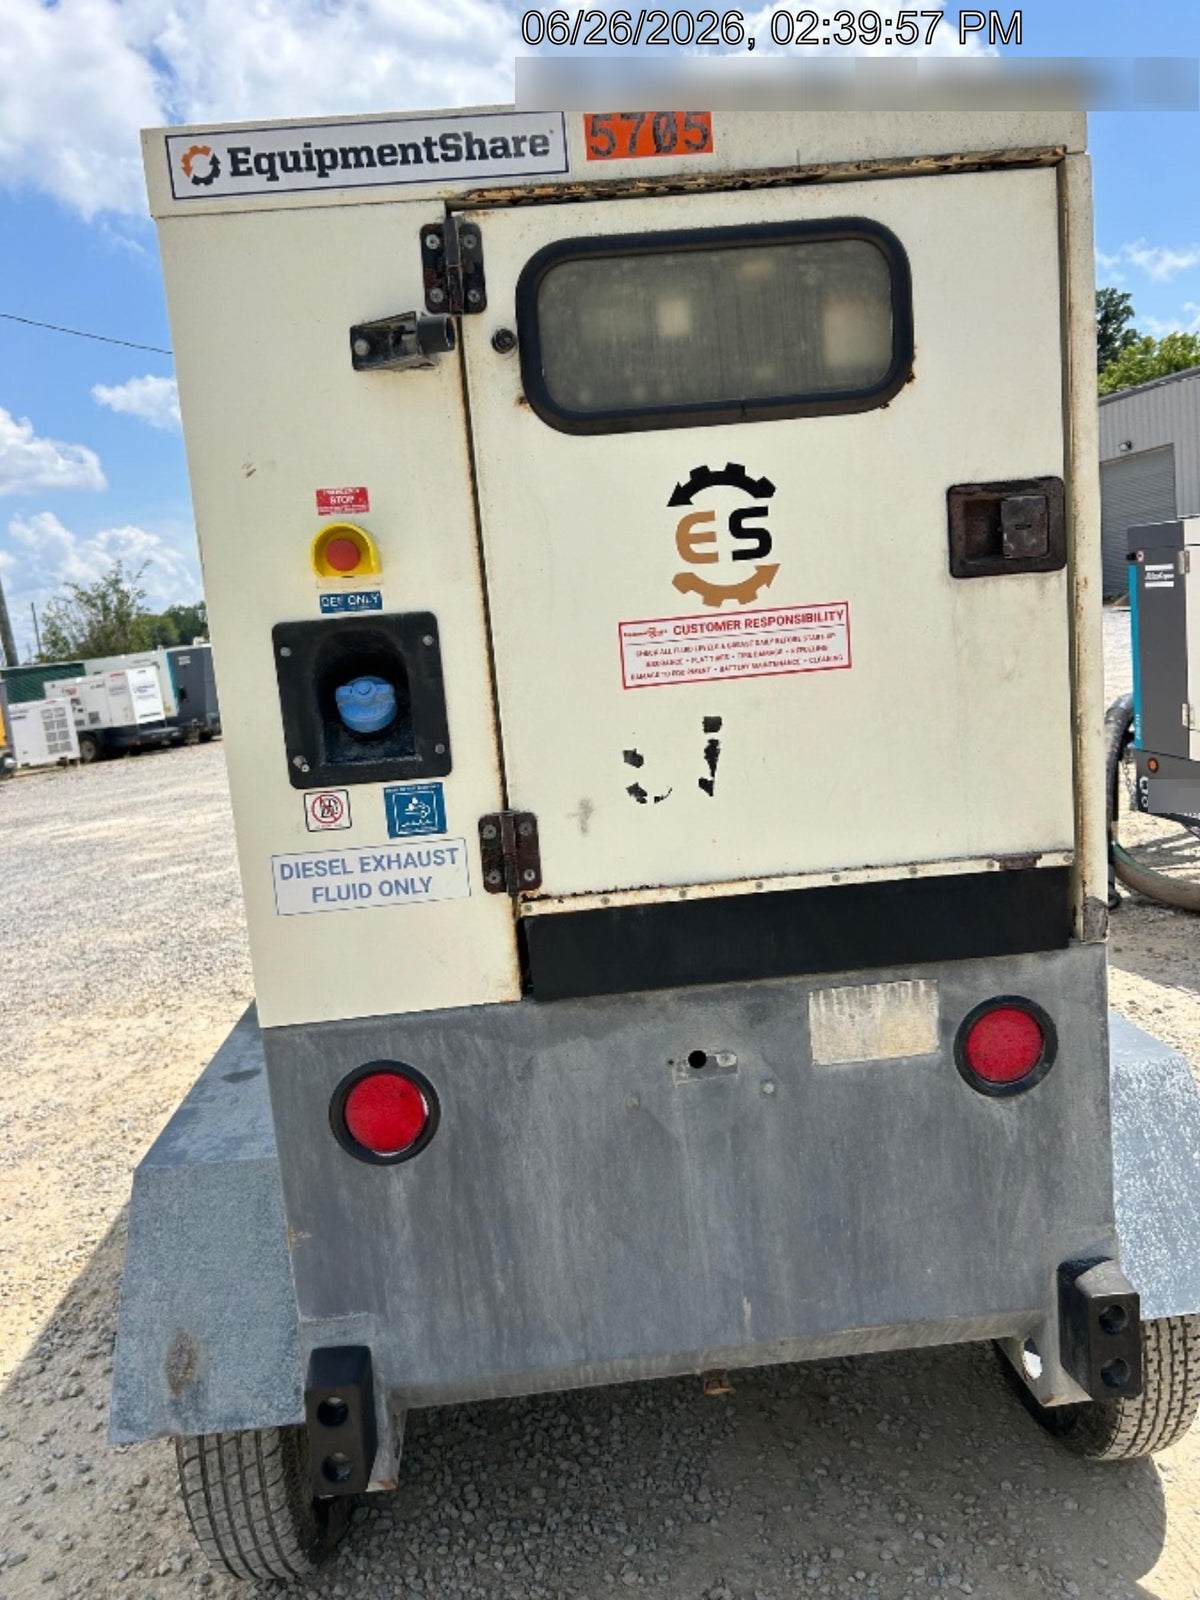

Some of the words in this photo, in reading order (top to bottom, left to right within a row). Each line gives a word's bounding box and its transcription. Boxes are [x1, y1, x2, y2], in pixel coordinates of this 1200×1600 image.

[588, 111, 710, 158] 5705
[227, 131, 550, 182] EquipmentShare
[347, 593, 380, 606] ONLY
[673, 620, 741, 635] CUSTOMER
[745, 609, 844, 629] RESPONSIBILITY
[280, 858, 354, 880] DIESEL
[359, 847, 459, 873] EXHAUST
[311, 882, 372, 904] FLUID
[378, 876, 433, 897] ONLY
